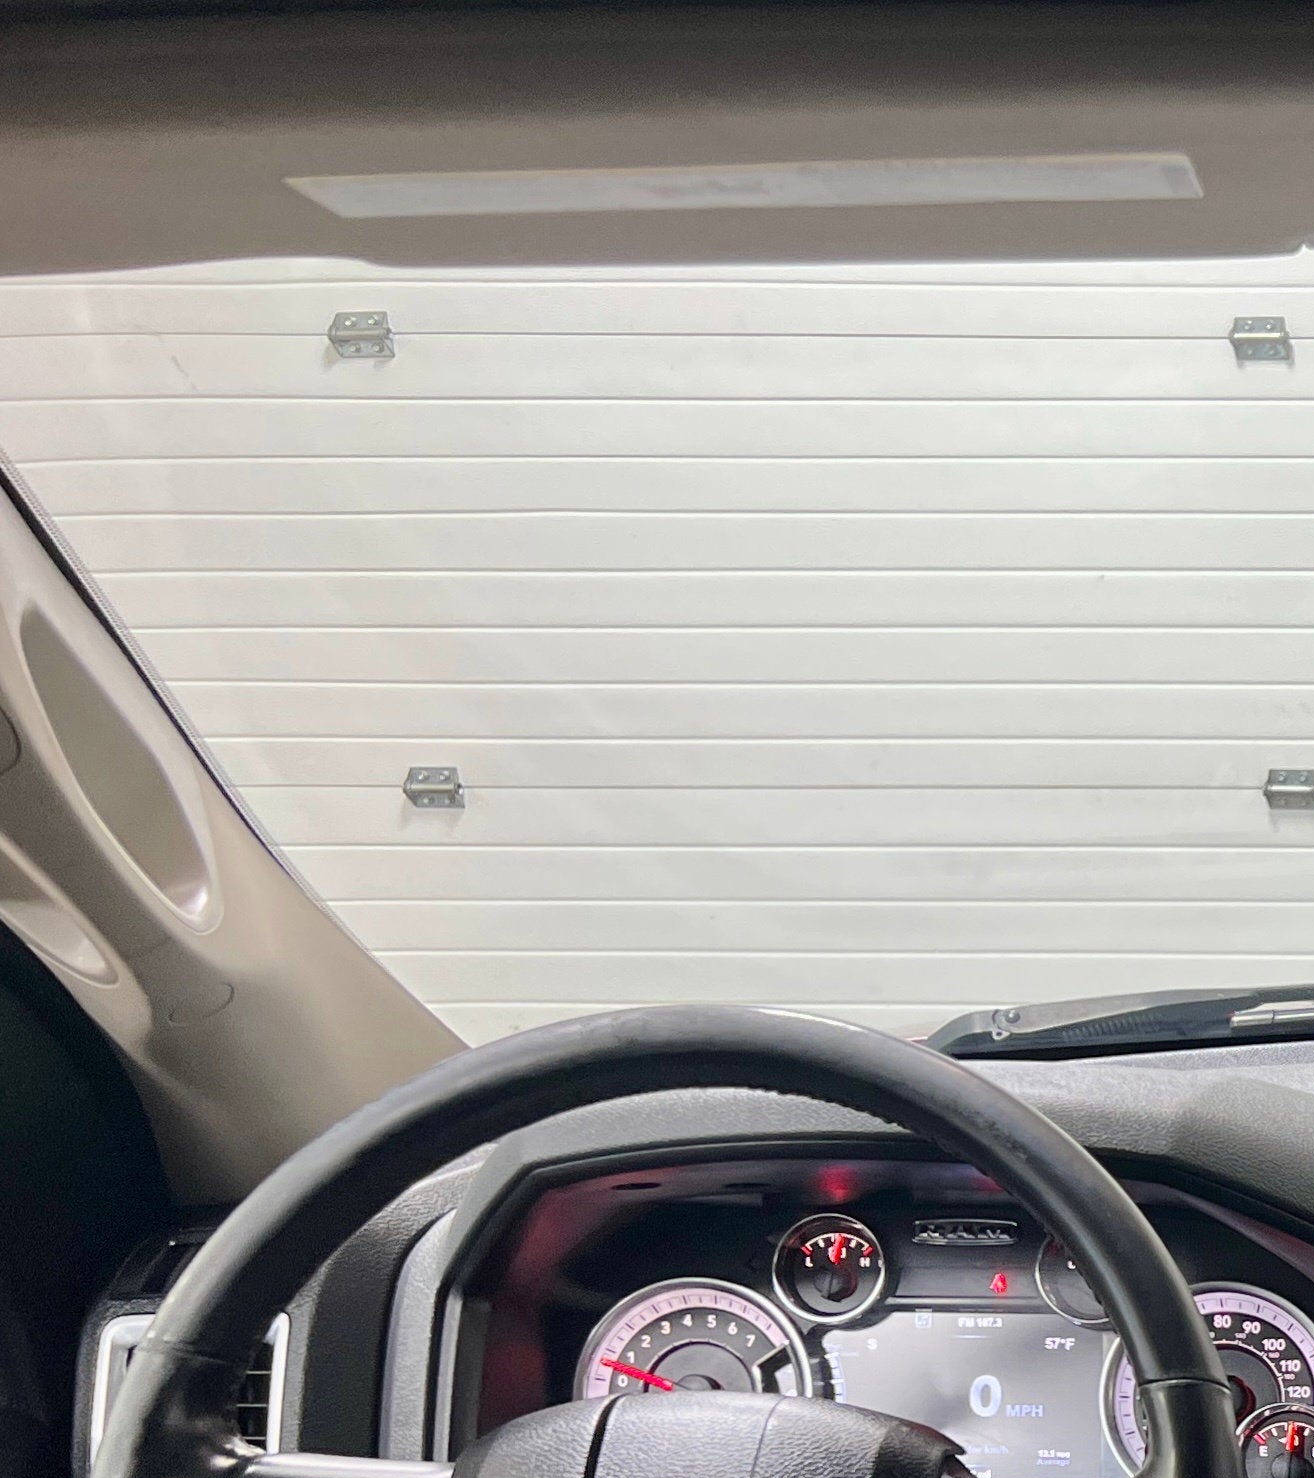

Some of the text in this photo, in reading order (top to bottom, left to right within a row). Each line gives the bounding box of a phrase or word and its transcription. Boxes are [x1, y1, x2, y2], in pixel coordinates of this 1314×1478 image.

[682, 1314, 693, 1327] 4
[707, 1314, 717, 1328] 5
[1213, 1315, 1231, 1328] 80
[660, 1321, 671, 1334] 3
[728, 1322, 738, 1335] 6
[1242, 1321, 1261, 1334] 90
[641, 1335, 651, 1347] 2
[746, 1334, 756, 1347] 7
[1262, 1338, 1286, 1351] 100
[627, 1351, 635, 1364] 1
[1279, 1359, 1301, 1372] 110
[618, 1375, 628, 1387] 0
[970, 1375, 1044, 1417] 0 MPH
[1287, 1386, 1310, 1398] 120
[1259, 1446, 1268, 1457] E
